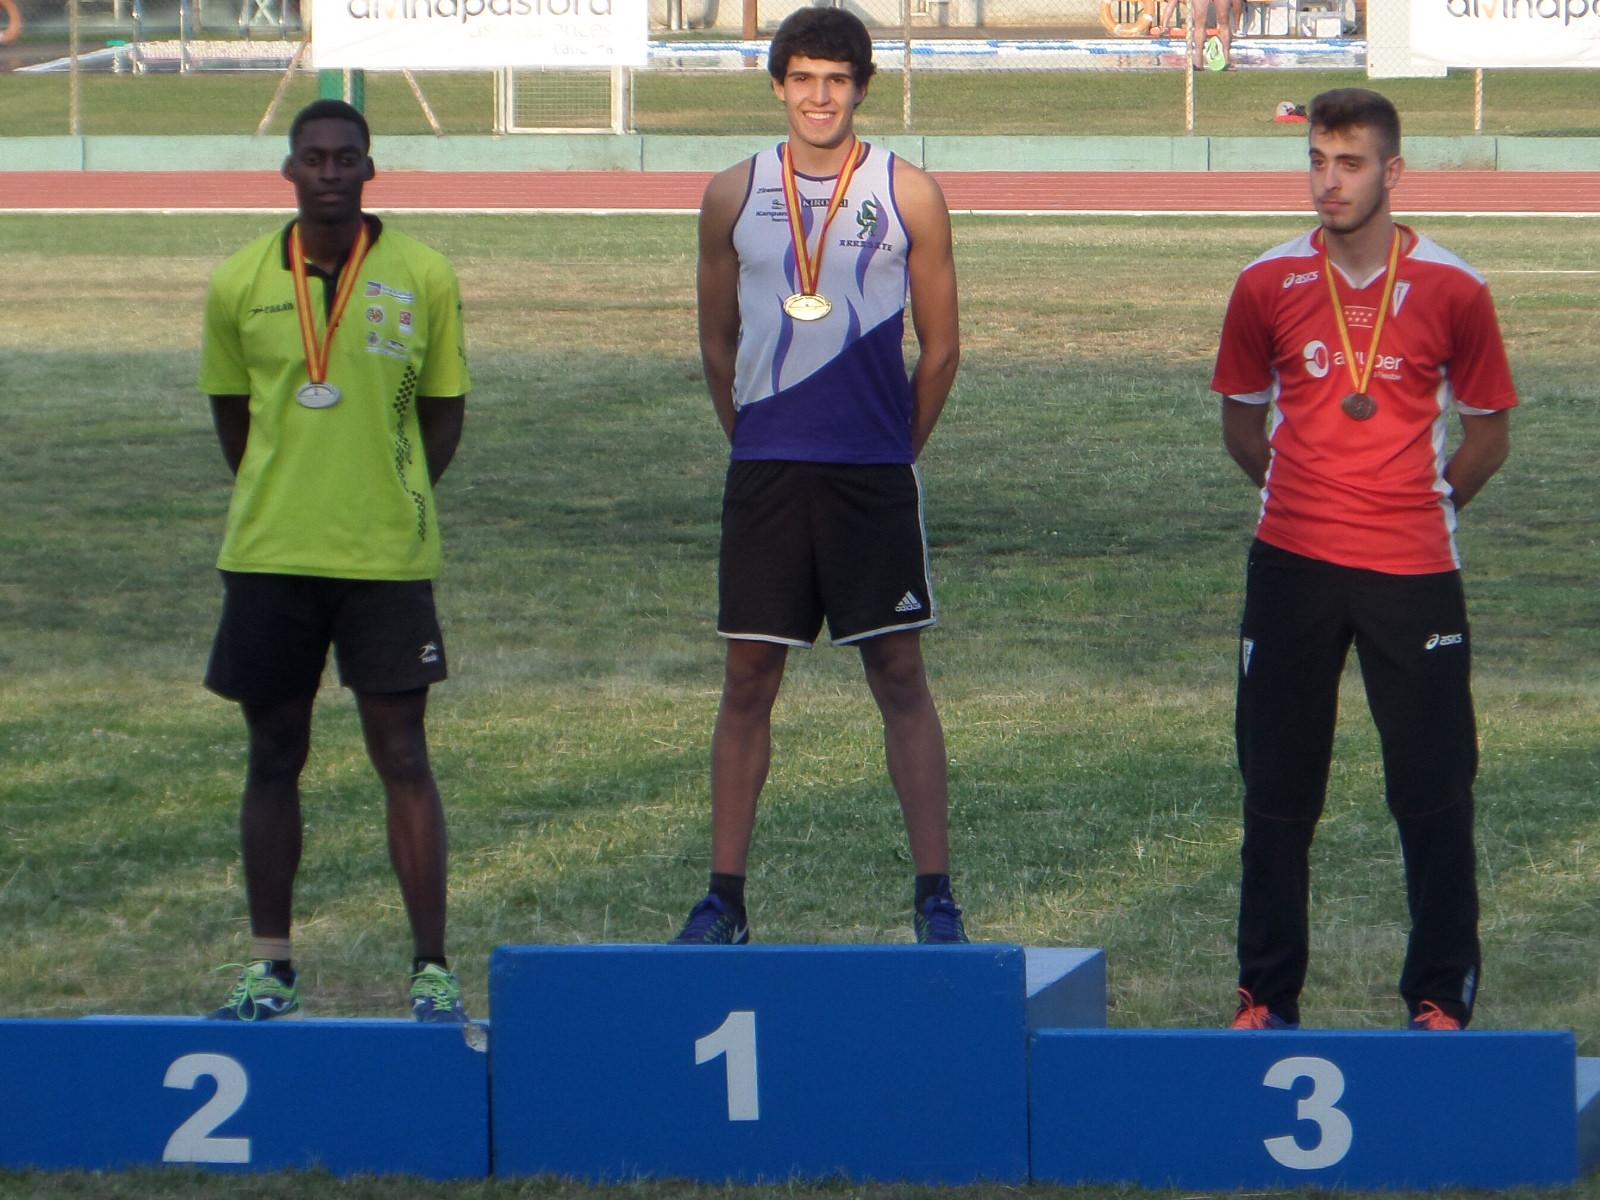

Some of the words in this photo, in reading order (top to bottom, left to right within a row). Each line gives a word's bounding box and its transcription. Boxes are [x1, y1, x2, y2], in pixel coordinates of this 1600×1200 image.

[162, 1053, 251, 1163] 2
[695, 1010, 760, 1122] 1
[1263, 1056, 1353, 1170] 3
